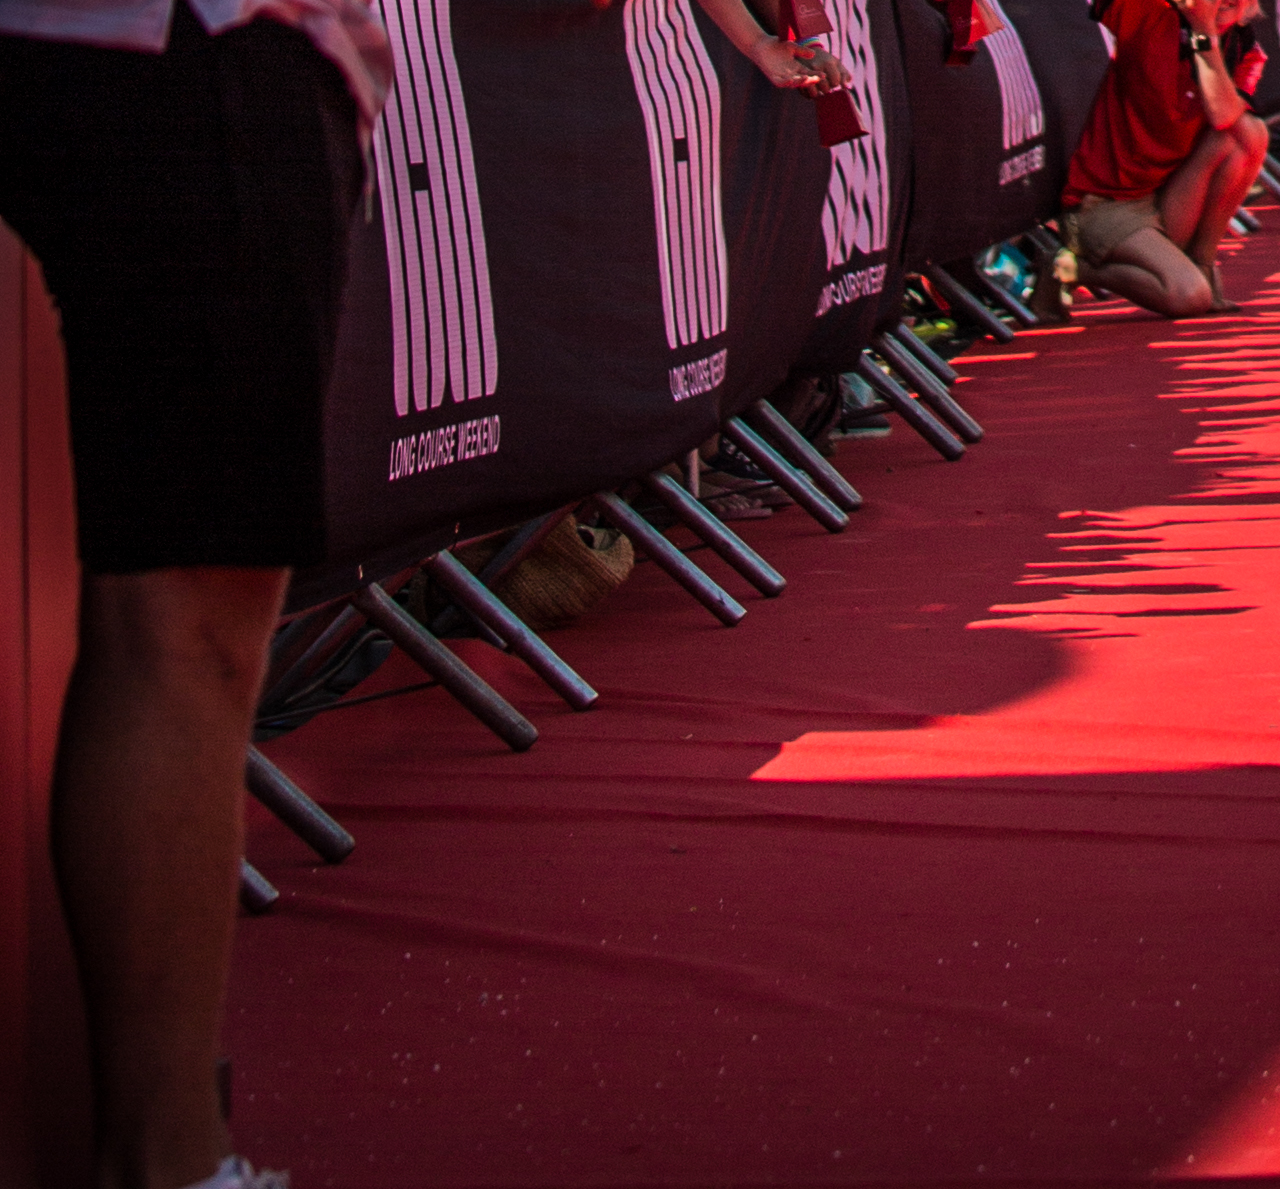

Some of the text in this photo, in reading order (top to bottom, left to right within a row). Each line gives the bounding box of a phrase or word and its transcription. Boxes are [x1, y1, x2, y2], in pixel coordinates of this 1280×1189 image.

[388, 413, 501, 482] LONG COURSE WEEKEND
